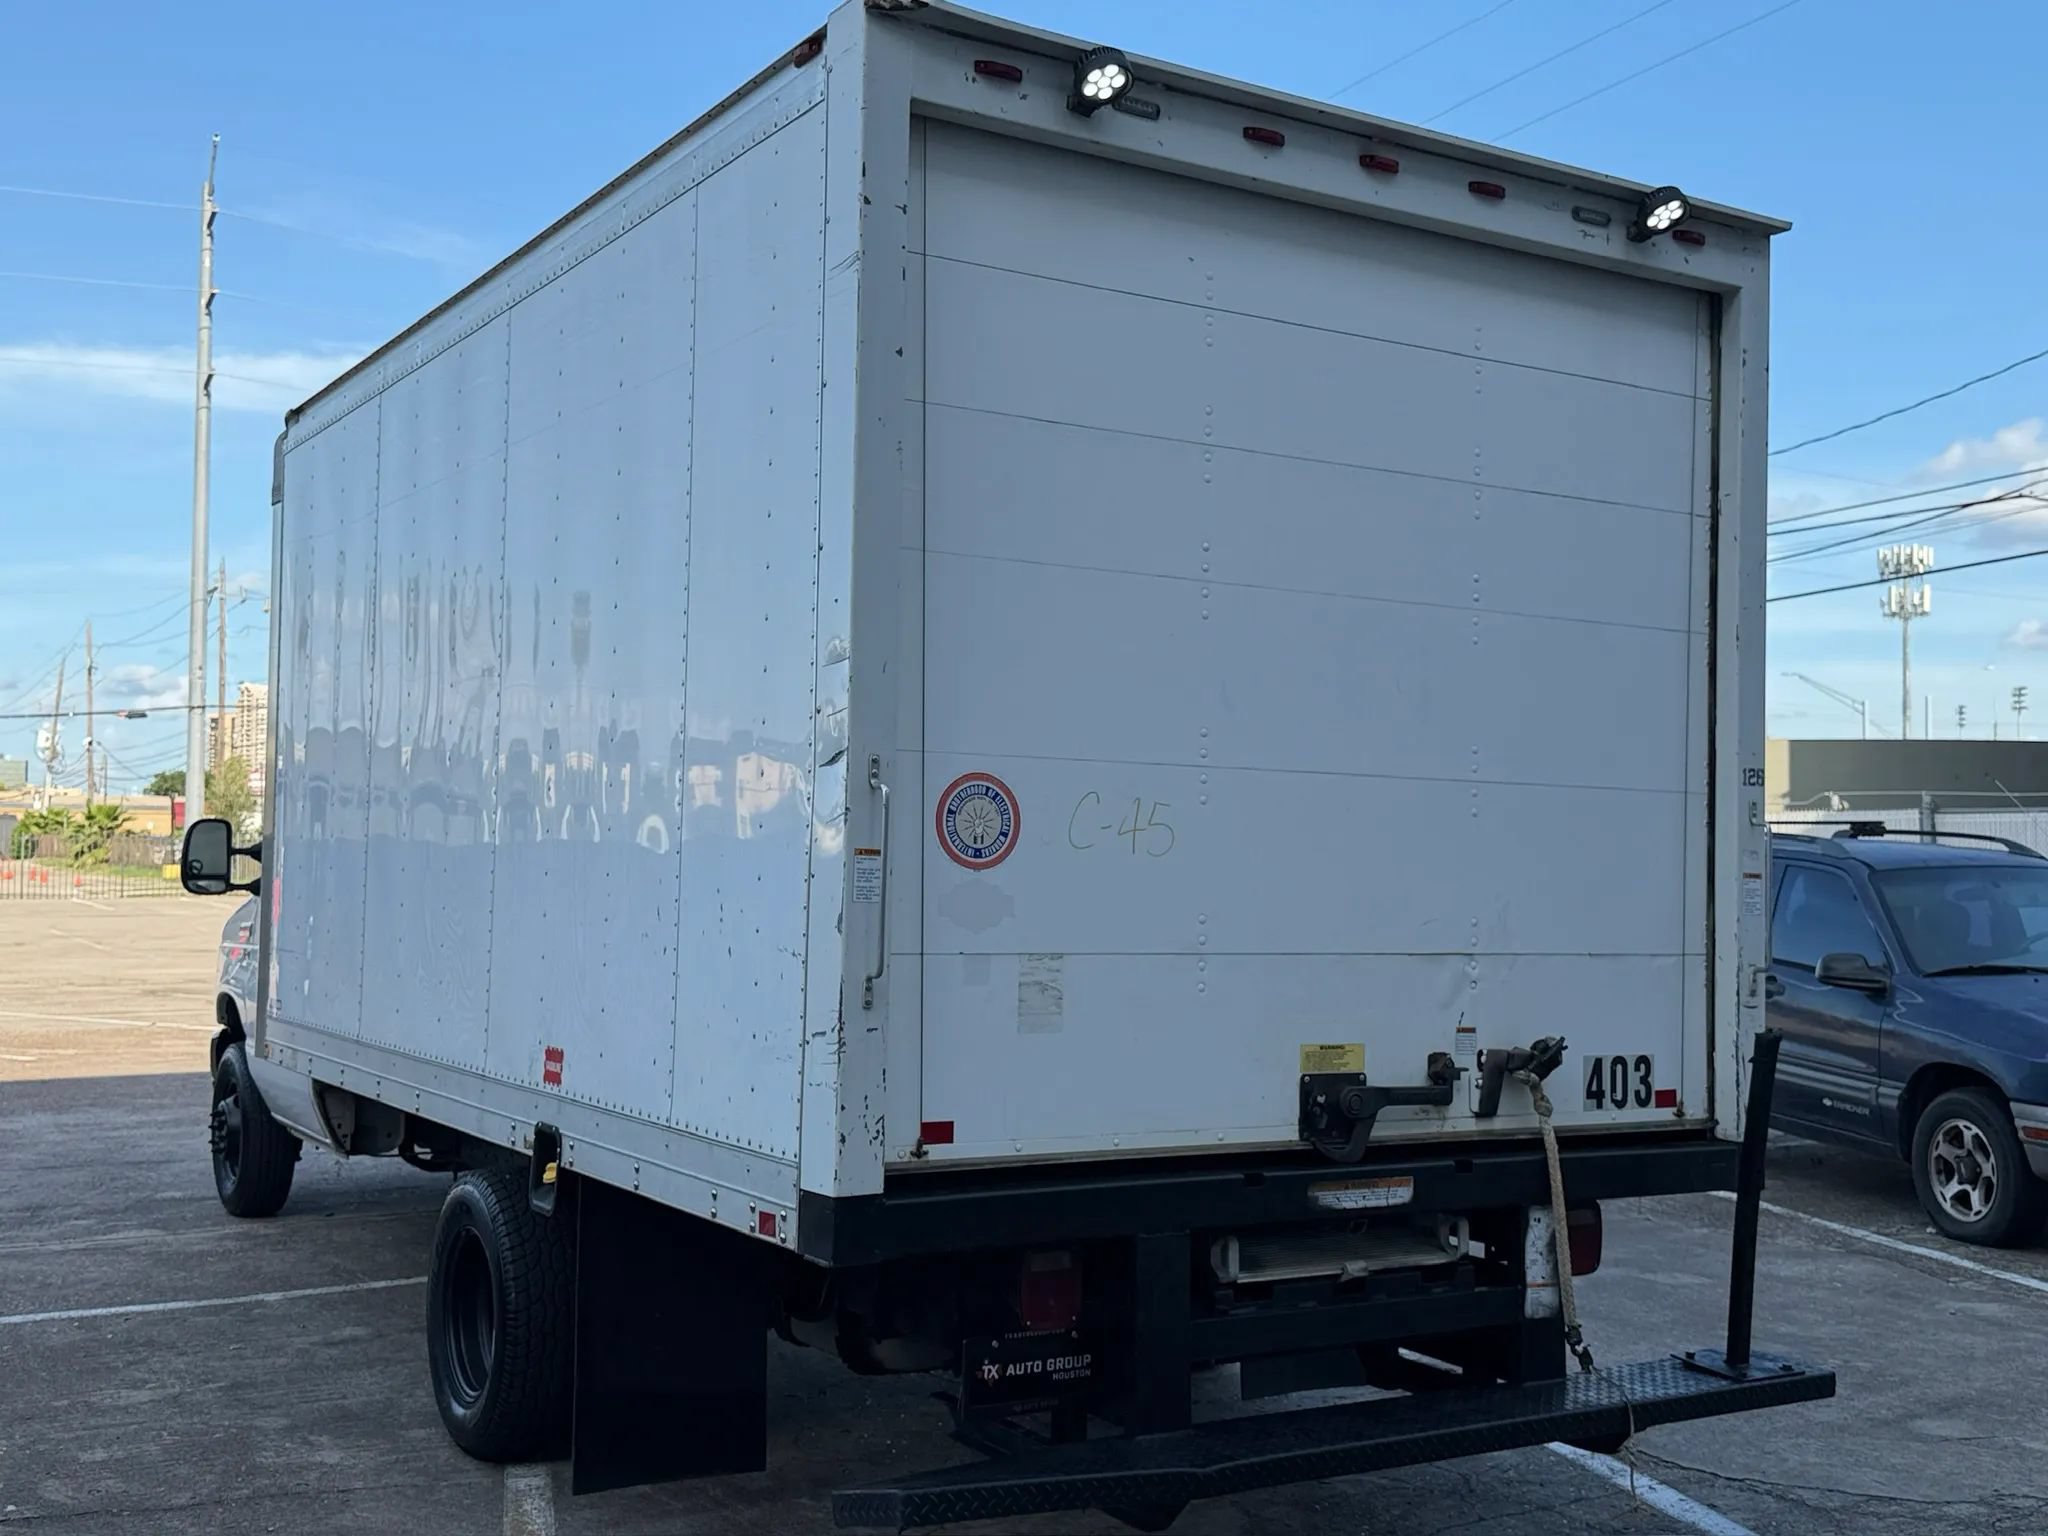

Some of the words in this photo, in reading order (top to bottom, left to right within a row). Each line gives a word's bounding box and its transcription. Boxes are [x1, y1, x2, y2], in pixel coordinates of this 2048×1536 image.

[951, 784, 987, 811] BROTHERHOOD
[994, 794, 1012, 835] ELECTRICAL
[1068, 791, 1175, 857] C-45
[1586, 1055, 1652, 1109] 403
[982, 1362, 1000, 1381] TX
[1006, 1360, 1042, 1376] AUTO
[1046, 1354, 1091, 1371] GROUP
[1052, 1369, 1091, 1381] HOUSTON
